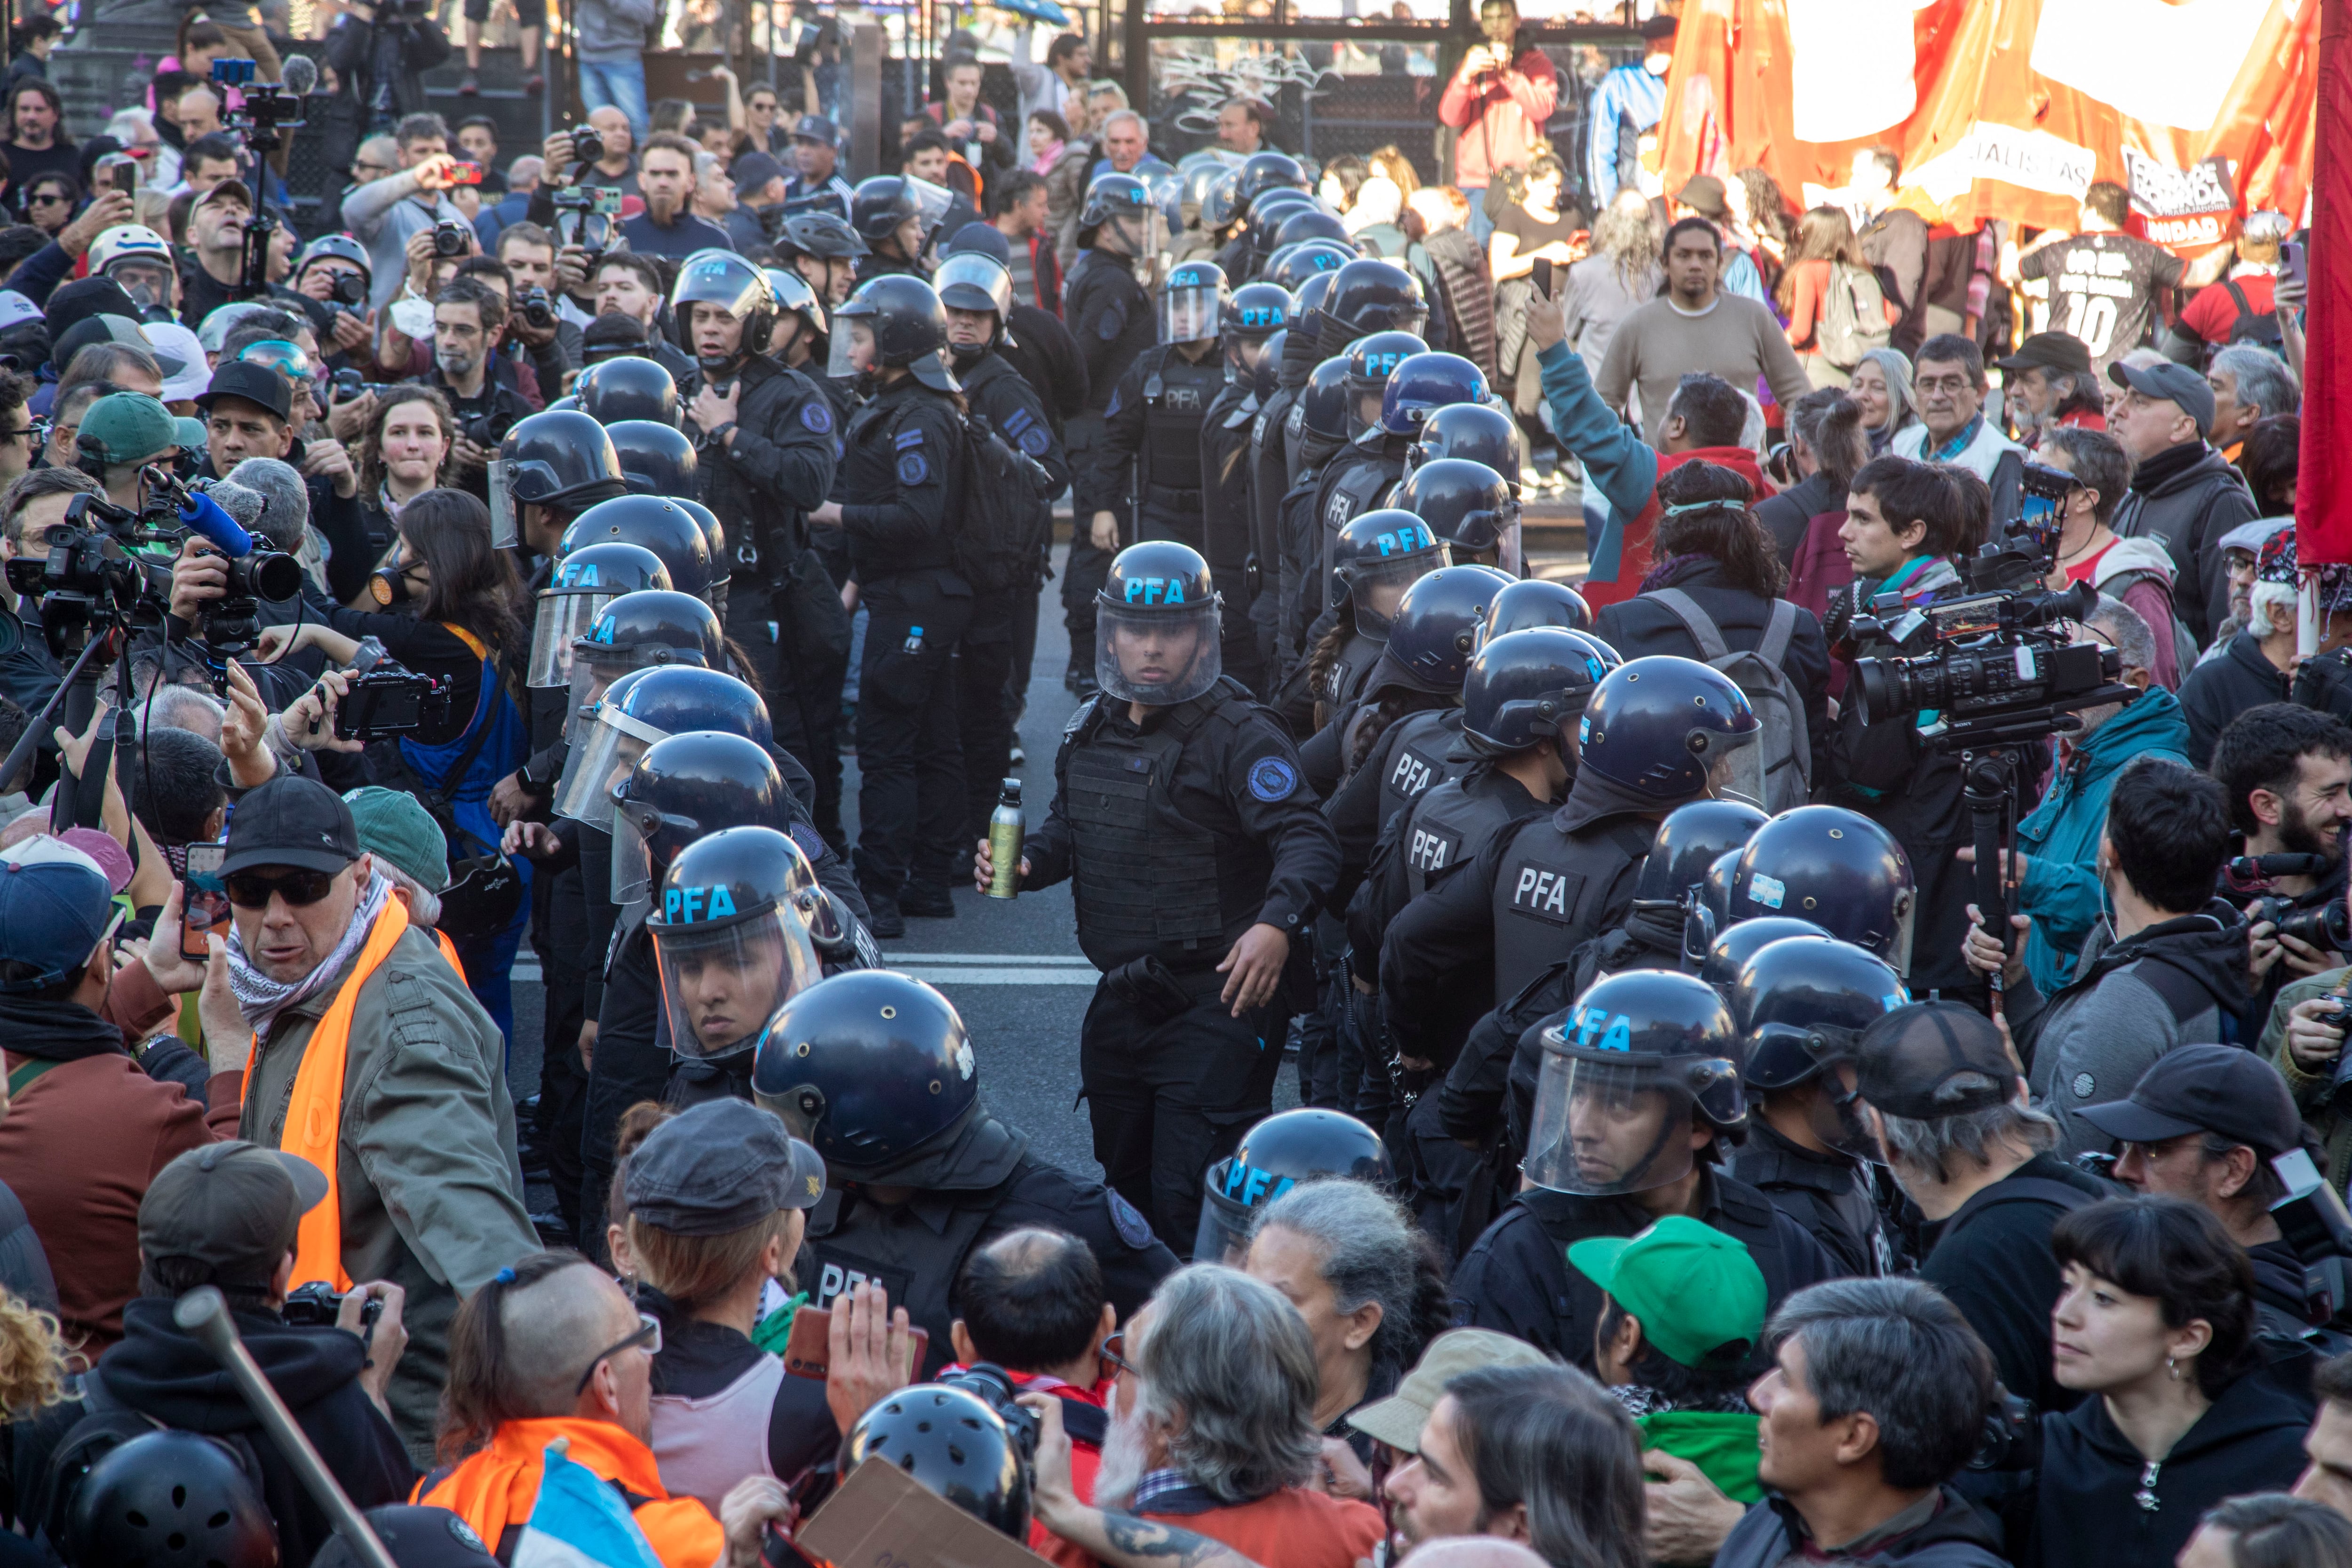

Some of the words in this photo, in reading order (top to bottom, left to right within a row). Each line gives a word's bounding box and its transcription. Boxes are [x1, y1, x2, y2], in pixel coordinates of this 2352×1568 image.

[1243, 306, 1284, 326] PFA
[2066, 293, 2118, 357] 10
[1166, 390, 1201, 410] PFA
[1328, 494, 1350, 526] PFA
[1377, 526, 1431, 556] PFA
[1126, 577, 1184, 605] PFA
[588, 613, 616, 645] FA
[1327, 663, 1342, 697] FA
[1392, 753, 1431, 796] PFA
[1411, 829, 1447, 871] PFA
[666, 884, 737, 925] PFA
[1515, 868, 1566, 915] PFA
